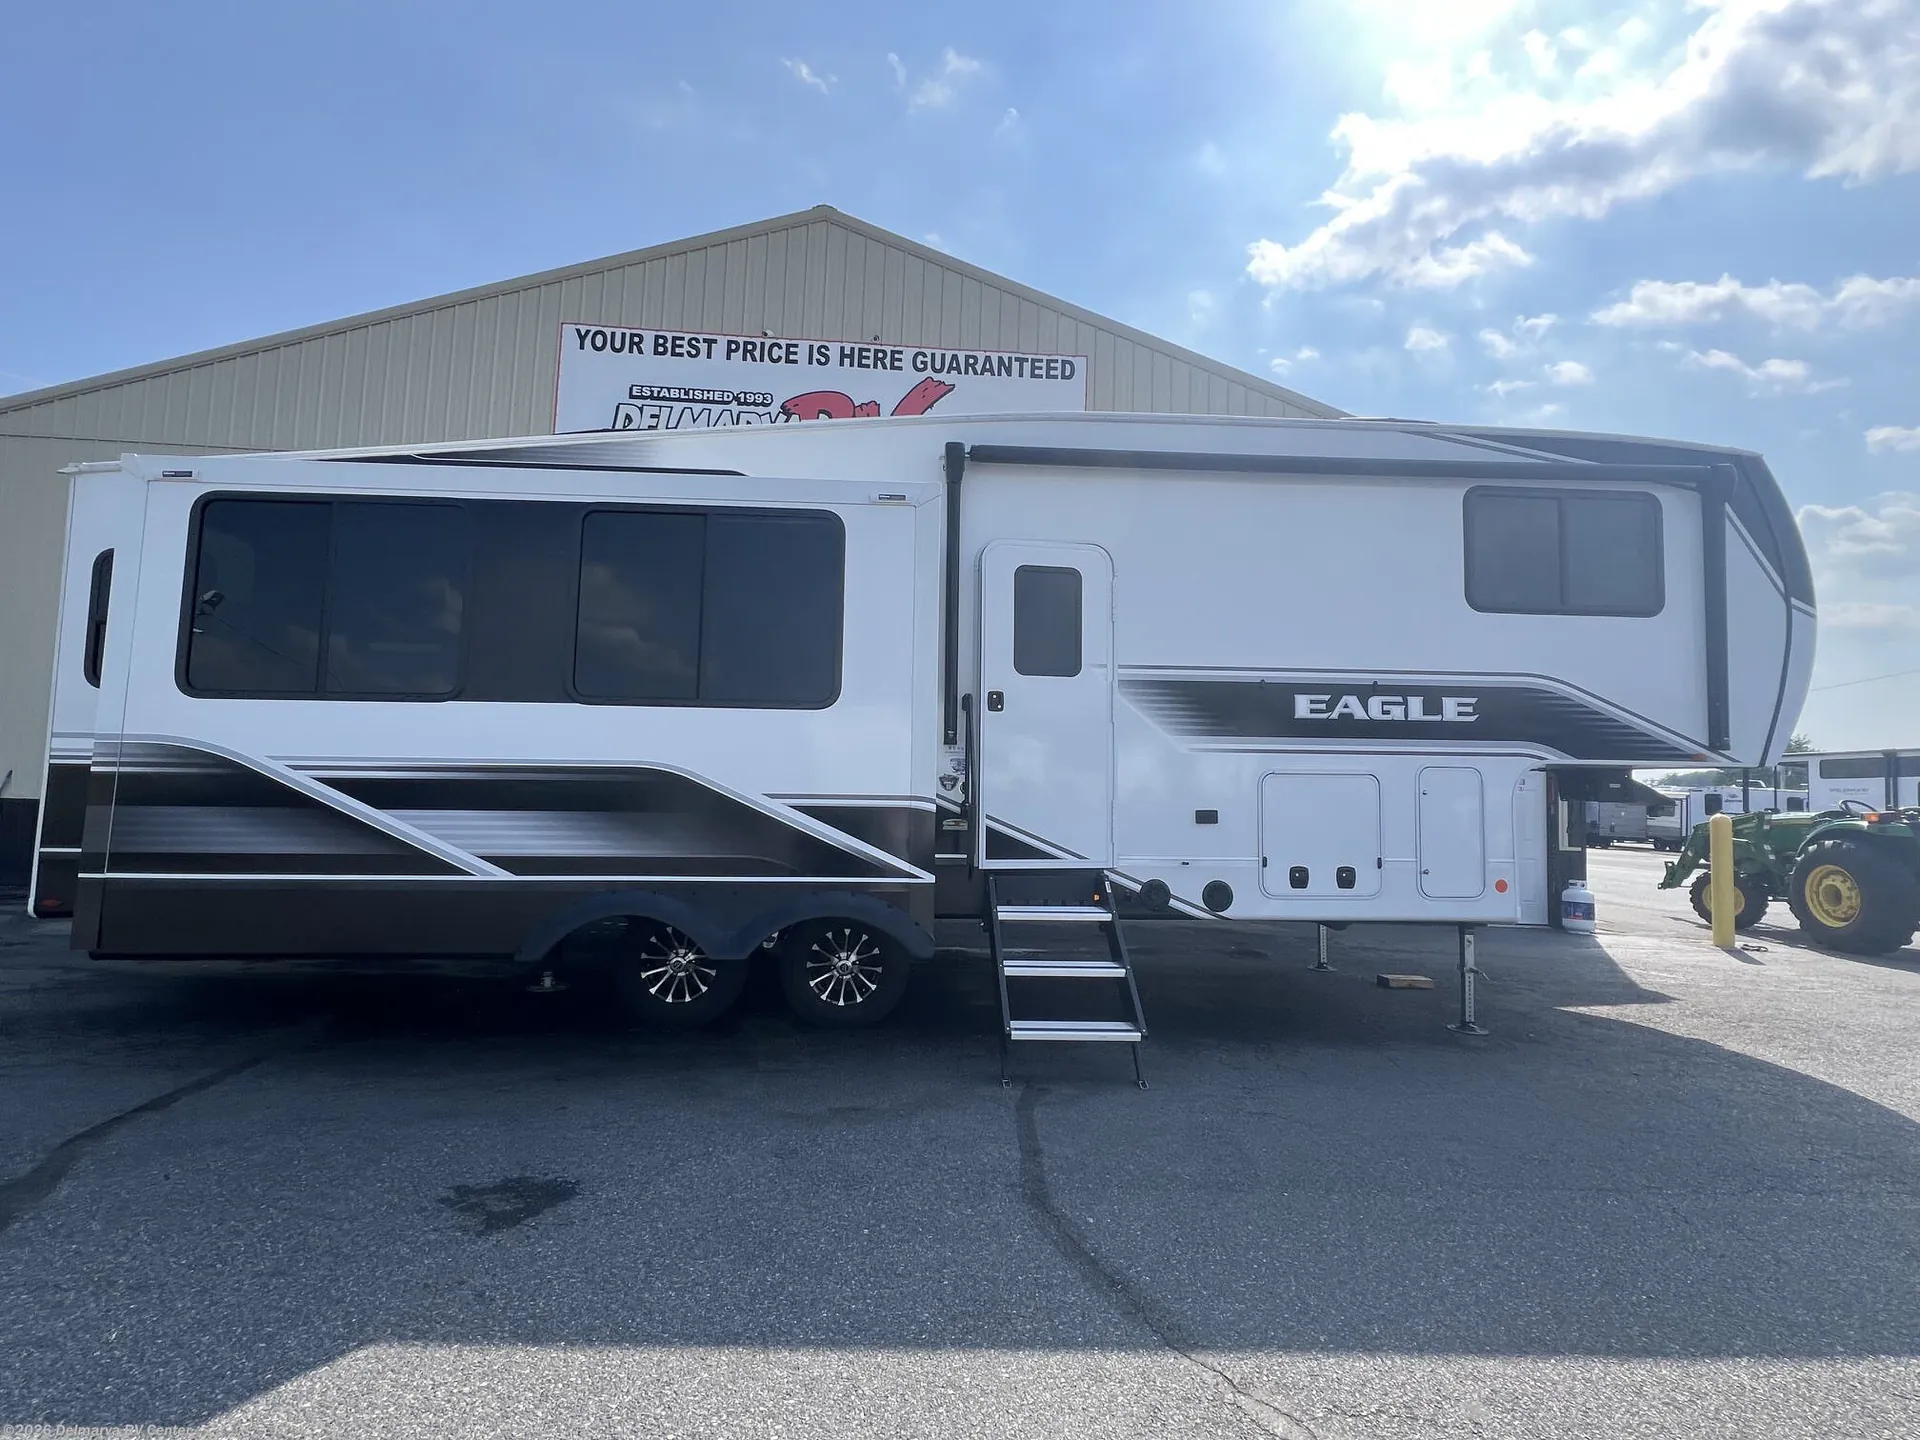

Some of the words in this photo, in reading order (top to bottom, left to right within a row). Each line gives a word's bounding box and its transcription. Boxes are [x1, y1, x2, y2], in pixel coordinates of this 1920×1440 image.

[575, 328, 645, 355] YOUR
[652, 334, 718, 360] BEST
[725, 339, 799, 365] PRICE
[807, 344, 831, 366] IS
[838, 346, 904, 371] HERE
[911, 351, 1076, 380] GUARANTEED
[631, 386, 734, 402] ESTABLISHED
[738, 391, 773, 406] 1993
[613, 402, 801, 430] DELMARV
[1293, 694, 1480, 722] EAGLE
